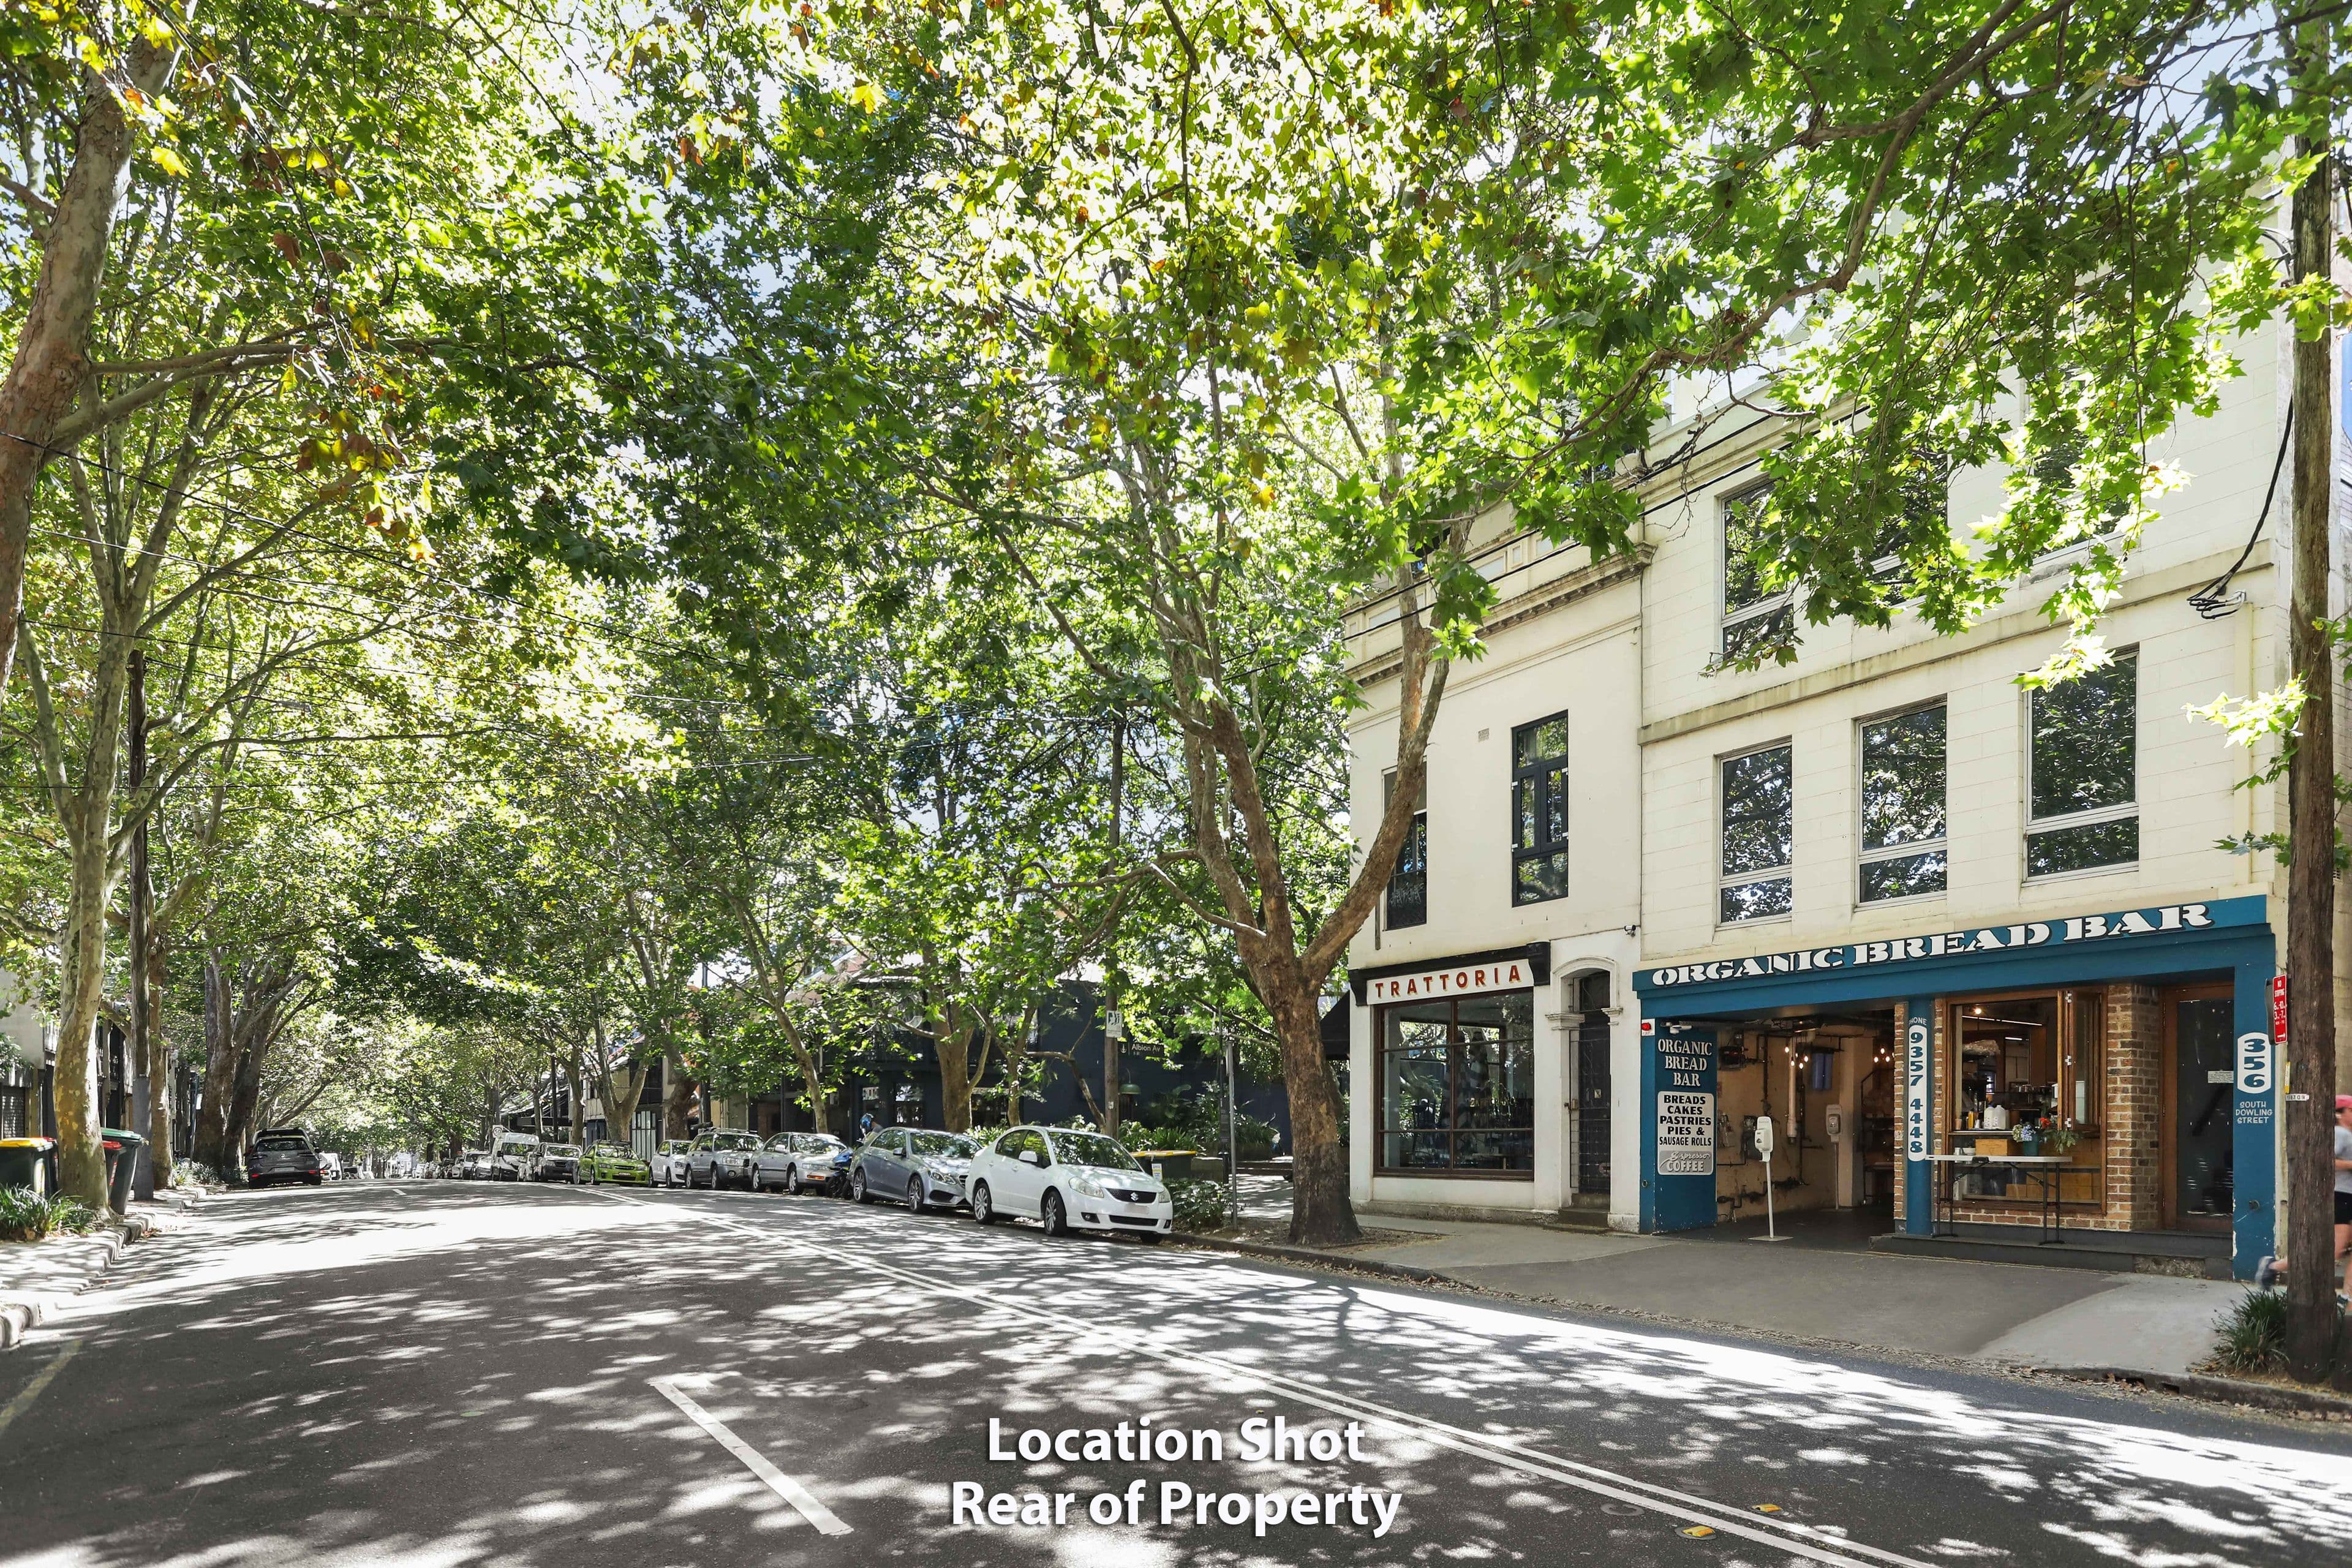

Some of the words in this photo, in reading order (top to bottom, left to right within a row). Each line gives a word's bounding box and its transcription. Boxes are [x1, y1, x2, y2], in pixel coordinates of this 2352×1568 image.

[1652, 948, 1843, 986] ORGANIC
[1852, 922, 2051, 965] BREAD
[2062, 903, 2213, 941] BAR
[1375, 965, 1521, 999] TRATTORIA
[1909, 1017, 1927, 1027] PHONE
[1131, 1043, 1151, 1052] Albion
[1657, 1039, 1713, 1055] ORGANIC
[1664, 1055, 1708, 1071] BREAD
[1910, 1032, 1923, 1086] 9357
[2244, 1038, 2266, 1088] 356
[1673, 1072, 1701, 1087] BAR
[1664, 1095, 1706, 1104] BREADS
[1667, 1106, 1703, 1115] CAKES
[1660, 1115, 1711, 1126] PASTRIES
[1910, 1098, 1924, 1153] 4448
[1667, 1126, 1691, 1135] PIES
[1696, 1127, 1705, 1136] &
[1659, 1136, 1689, 1146] SAUSAGE
[1691, 1137, 1711, 1147] ROLLS
[1660, 1152, 1711, 1163] Espresso
[1667, 1161, 1704, 1172] COFFEE
